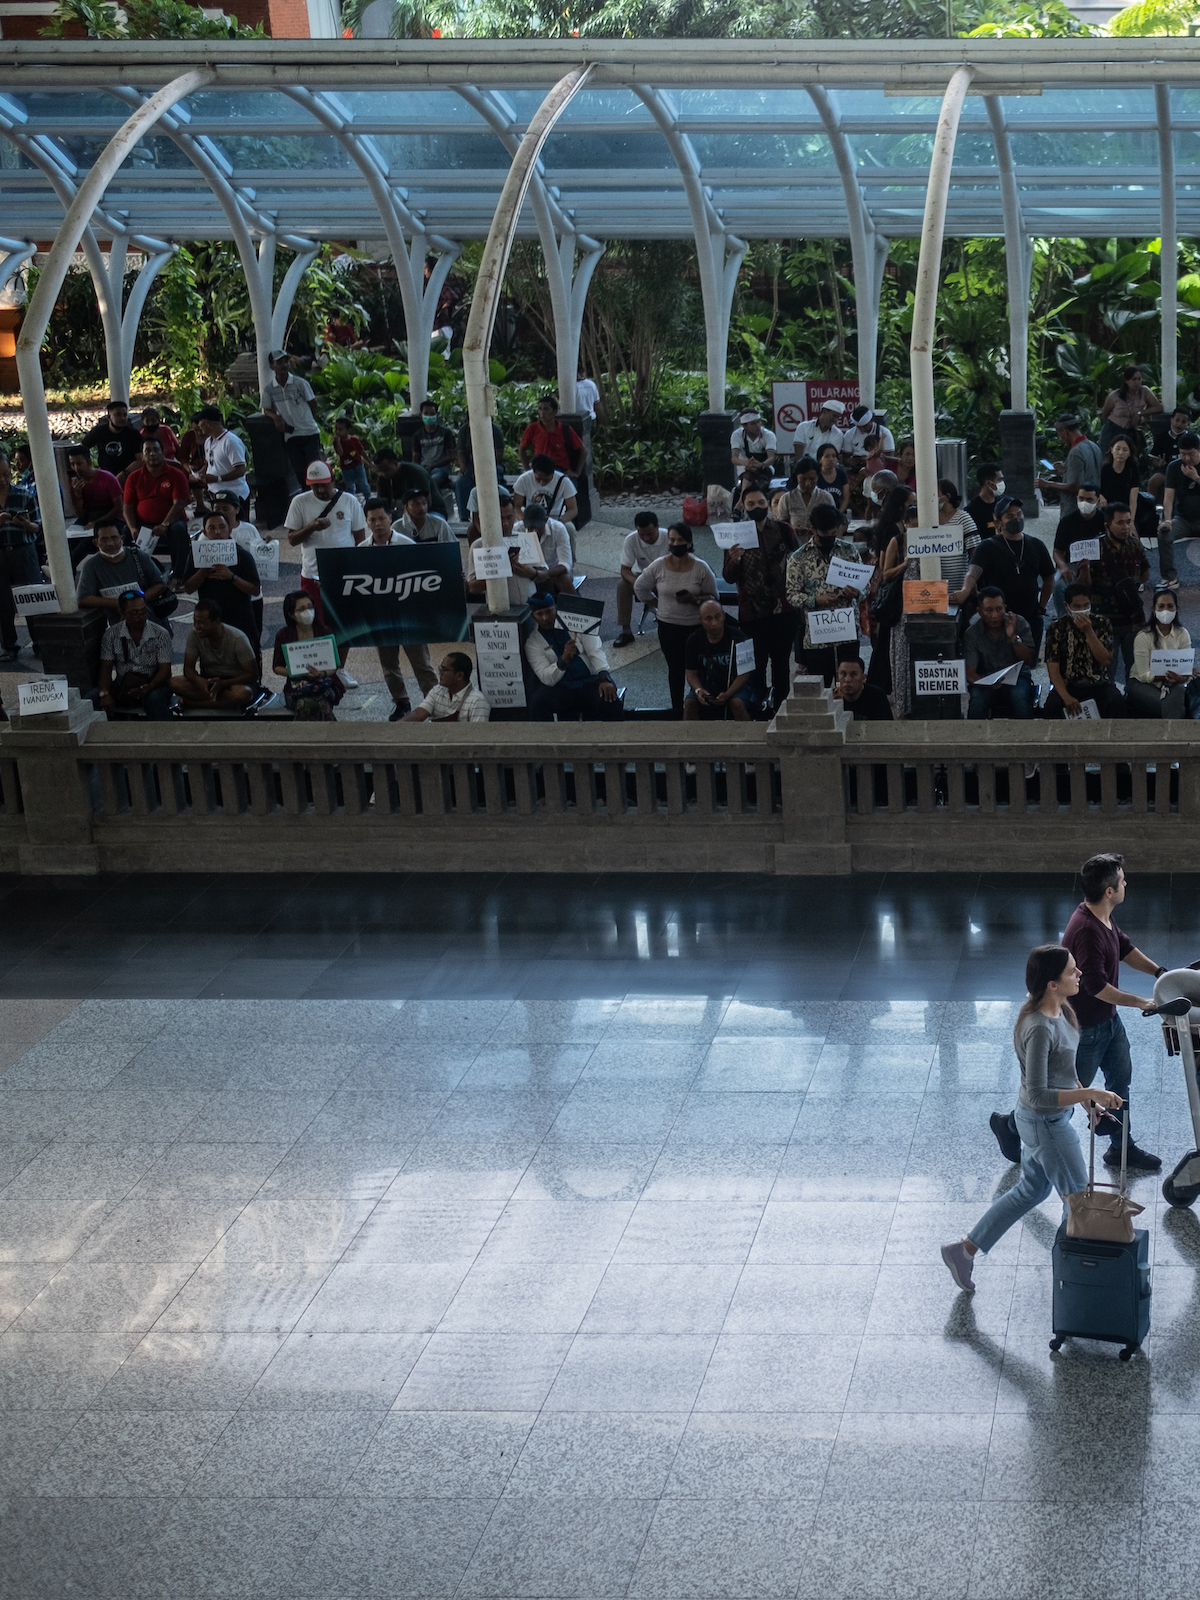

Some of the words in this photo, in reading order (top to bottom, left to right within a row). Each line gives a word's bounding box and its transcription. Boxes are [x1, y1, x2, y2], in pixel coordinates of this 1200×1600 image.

[811, 387, 860, 398] DILARANG
[198, 542, 235, 553] MOSTAFA
[907, 544, 931, 555] Club
[932, 542, 954, 553] Med
[198, 553, 235, 563] MOKHTAR
[838, 571, 860, 580] ELLIE
[342, 570, 442, 601] Ruijie
[14, 590, 57, 605] LODEWIJK
[812, 610, 852, 626] TRACY
[487, 642, 507, 650] SINGH
[918, 667, 959, 678] SBASTIAN
[30, 682, 56, 694] IRENA
[918, 680, 959, 691] RIEMER
[23, 692, 64, 705] IVANOVSKA
